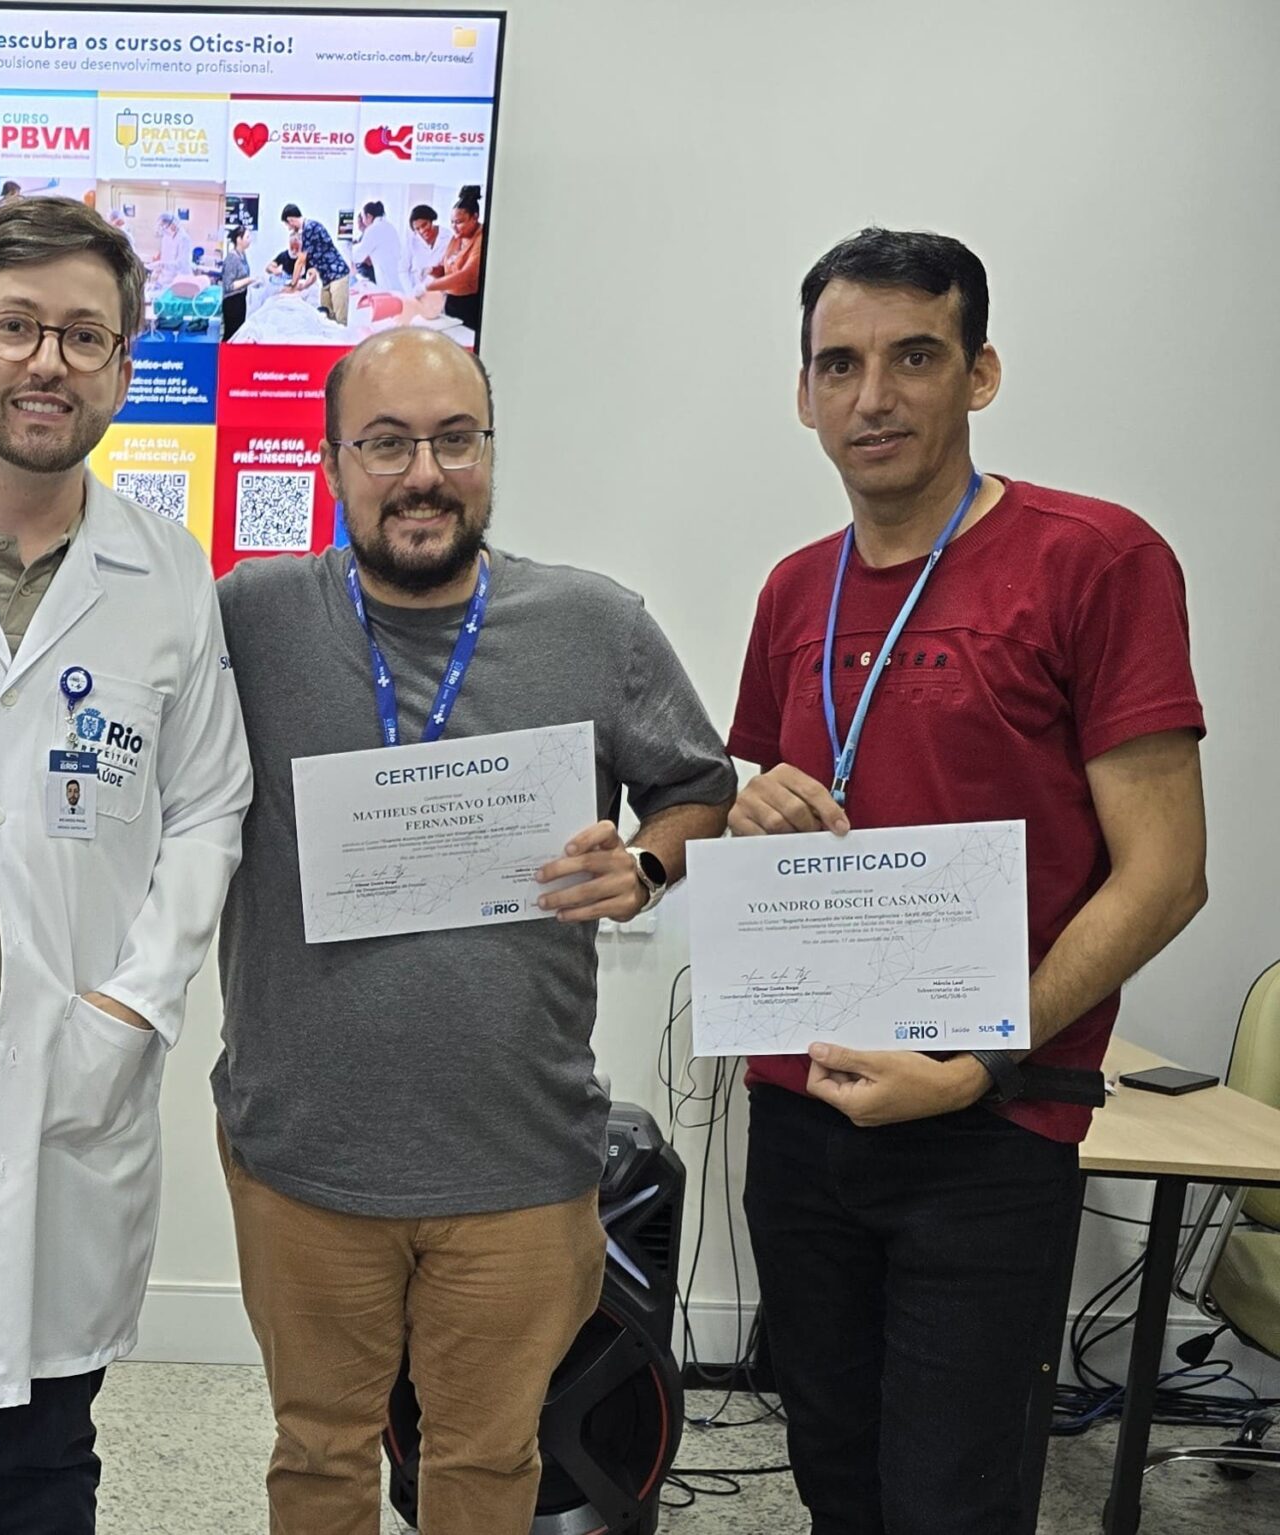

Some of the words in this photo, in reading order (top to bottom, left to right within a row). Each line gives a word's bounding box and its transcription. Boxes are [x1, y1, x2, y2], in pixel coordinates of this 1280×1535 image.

[85, 37, 107, 50] os
[115, 37, 182, 52] cursos
[189, 35, 293, 54] Otics-Rio!
[54, 59, 76, 70] seu
[81, 58, 192, 72] desenvolvimento
[196, 60, 273, 75] profissional.
[3, 113, 48, 124] CURSO
[141, 113, 194, 125] CURSO
[282, 123, 316, 132] CURSO
[417, 122, 449, 131] CURSO
[2, 126, 90, 150] PBVM
[282, 132, 355, 144] SAVE-RIO
[417, 132, 485, 143] URGE-SUS
[141, 141, 209, 155] VA-SUS
[124, 438, 153, 450] FAÇA
[156, 438, 179, 449] SUA
[249, 437, 282, 451] FAÇA
[282, 438, 305, 450] SUA
[109, 449, 196, 463] PRÉ-INSCRIÇÃO
[233, 450, 321, 466] PRÉ-INSCRIÇÃO
[813, 651, 949, 673] GNGSTER
[105, 721, 143, 754] Rio
[375, 756, 509, 786] CERTIFICADO
[352, 806, 417, 823] MATHEUS
[420, 798, 484, 815] GUSTAVO
[487, 792, 536, 808] LOMBA
[405, 813, 485, 832] FERNANDES
[777, 851, 927, 876] CERTIFICADO
[494, 903, 519, 915] RIO
[747, 899, 820, 914] YOANDRO
[824, 897, 873, 910] BOSCH
[878, 893, 961, 908] CASANOVA
[909, 1025, 939, 1039] RIO
